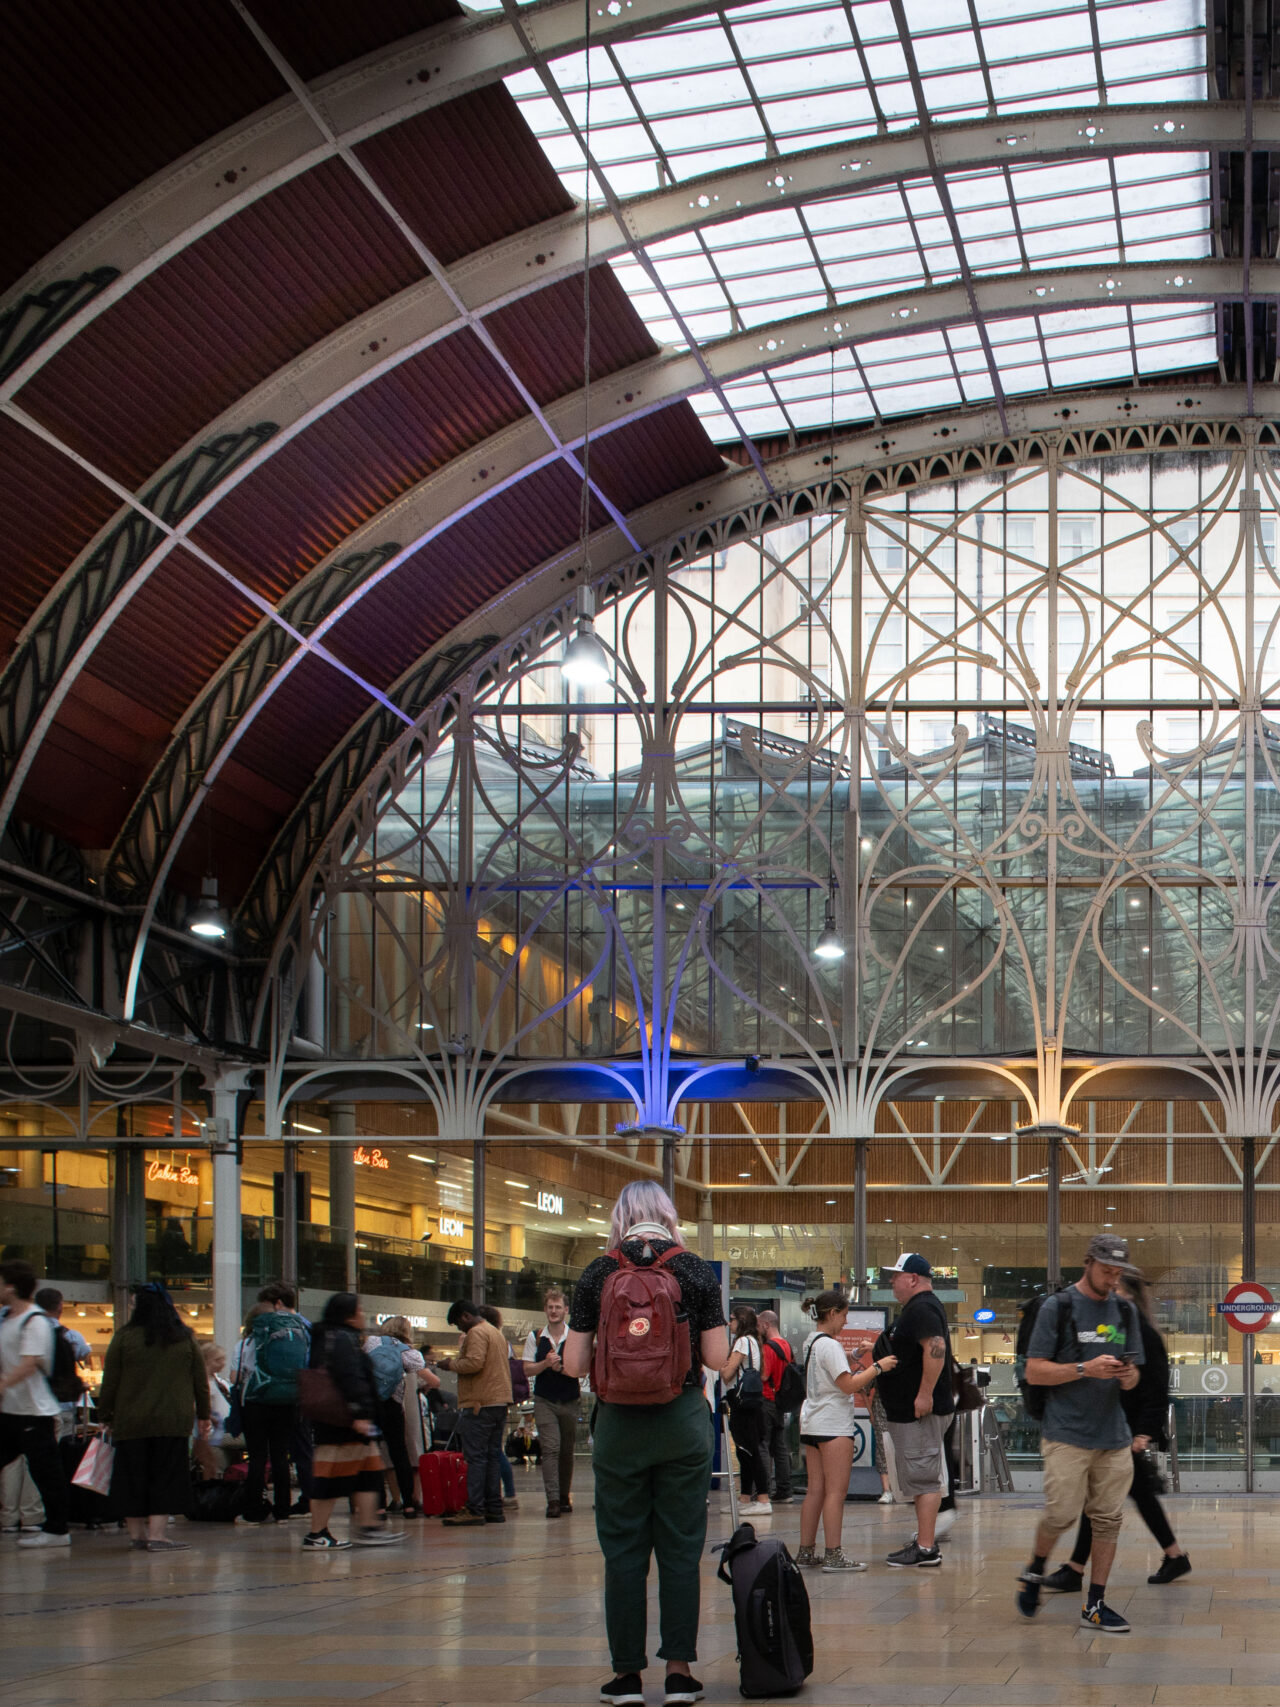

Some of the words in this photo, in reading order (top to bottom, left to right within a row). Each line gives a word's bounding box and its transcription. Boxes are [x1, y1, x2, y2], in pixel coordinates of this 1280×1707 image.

[148, 1160, 178, 1182] Cabin
[180, 1167, 200, 1185] Bar
[537, 1191, 563, 1216] LEON
[439, 1216, 464, 1237] LEON
[1220, 1304, 1278, 1312] UNDERGROUND
